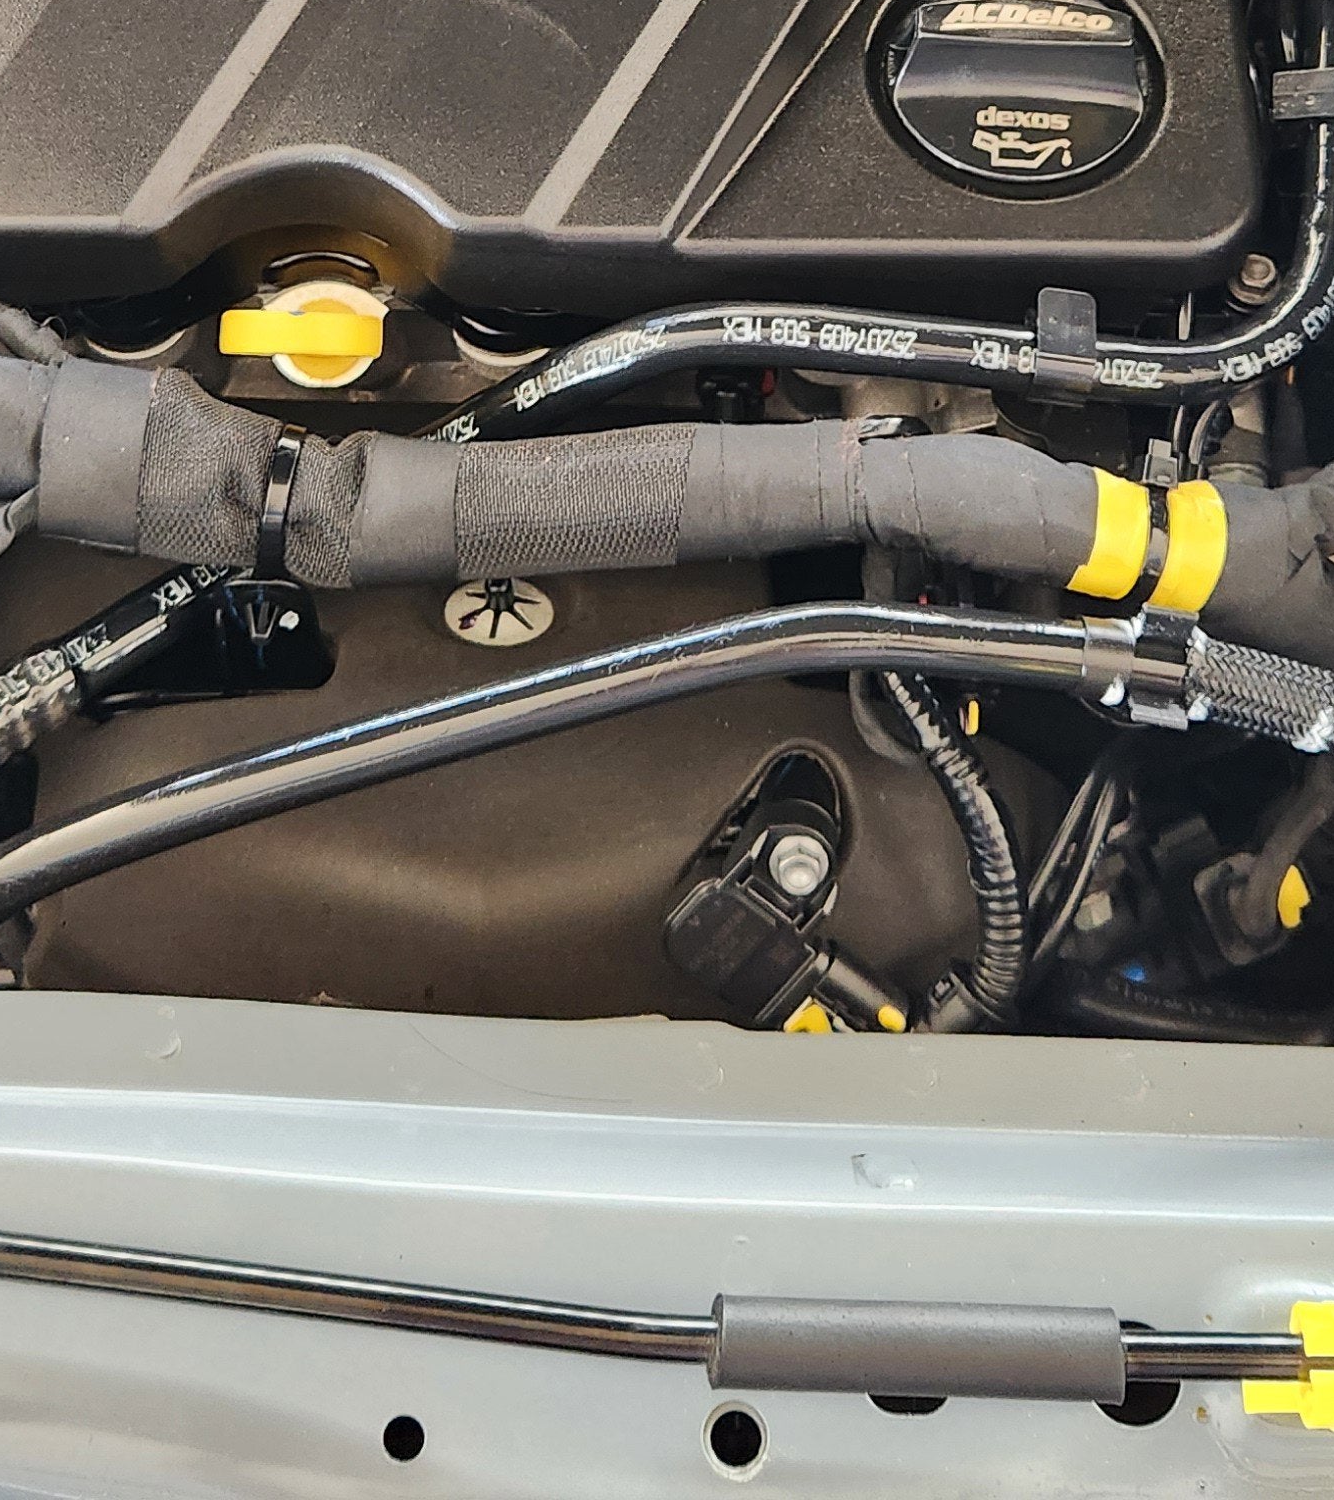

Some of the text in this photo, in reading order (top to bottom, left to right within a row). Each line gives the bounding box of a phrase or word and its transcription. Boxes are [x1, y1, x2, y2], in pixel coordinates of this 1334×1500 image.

[939, 2, 1115, 32] ACDelco
[975, 105, 1072, 131] dexos
[721, 315, 917, 360] 25207409 503 MEX
[969, 339, 1010, 372] MEX
[1217, 351, 1263, 384] MEX
[151, 575, 193, 613] MEX
